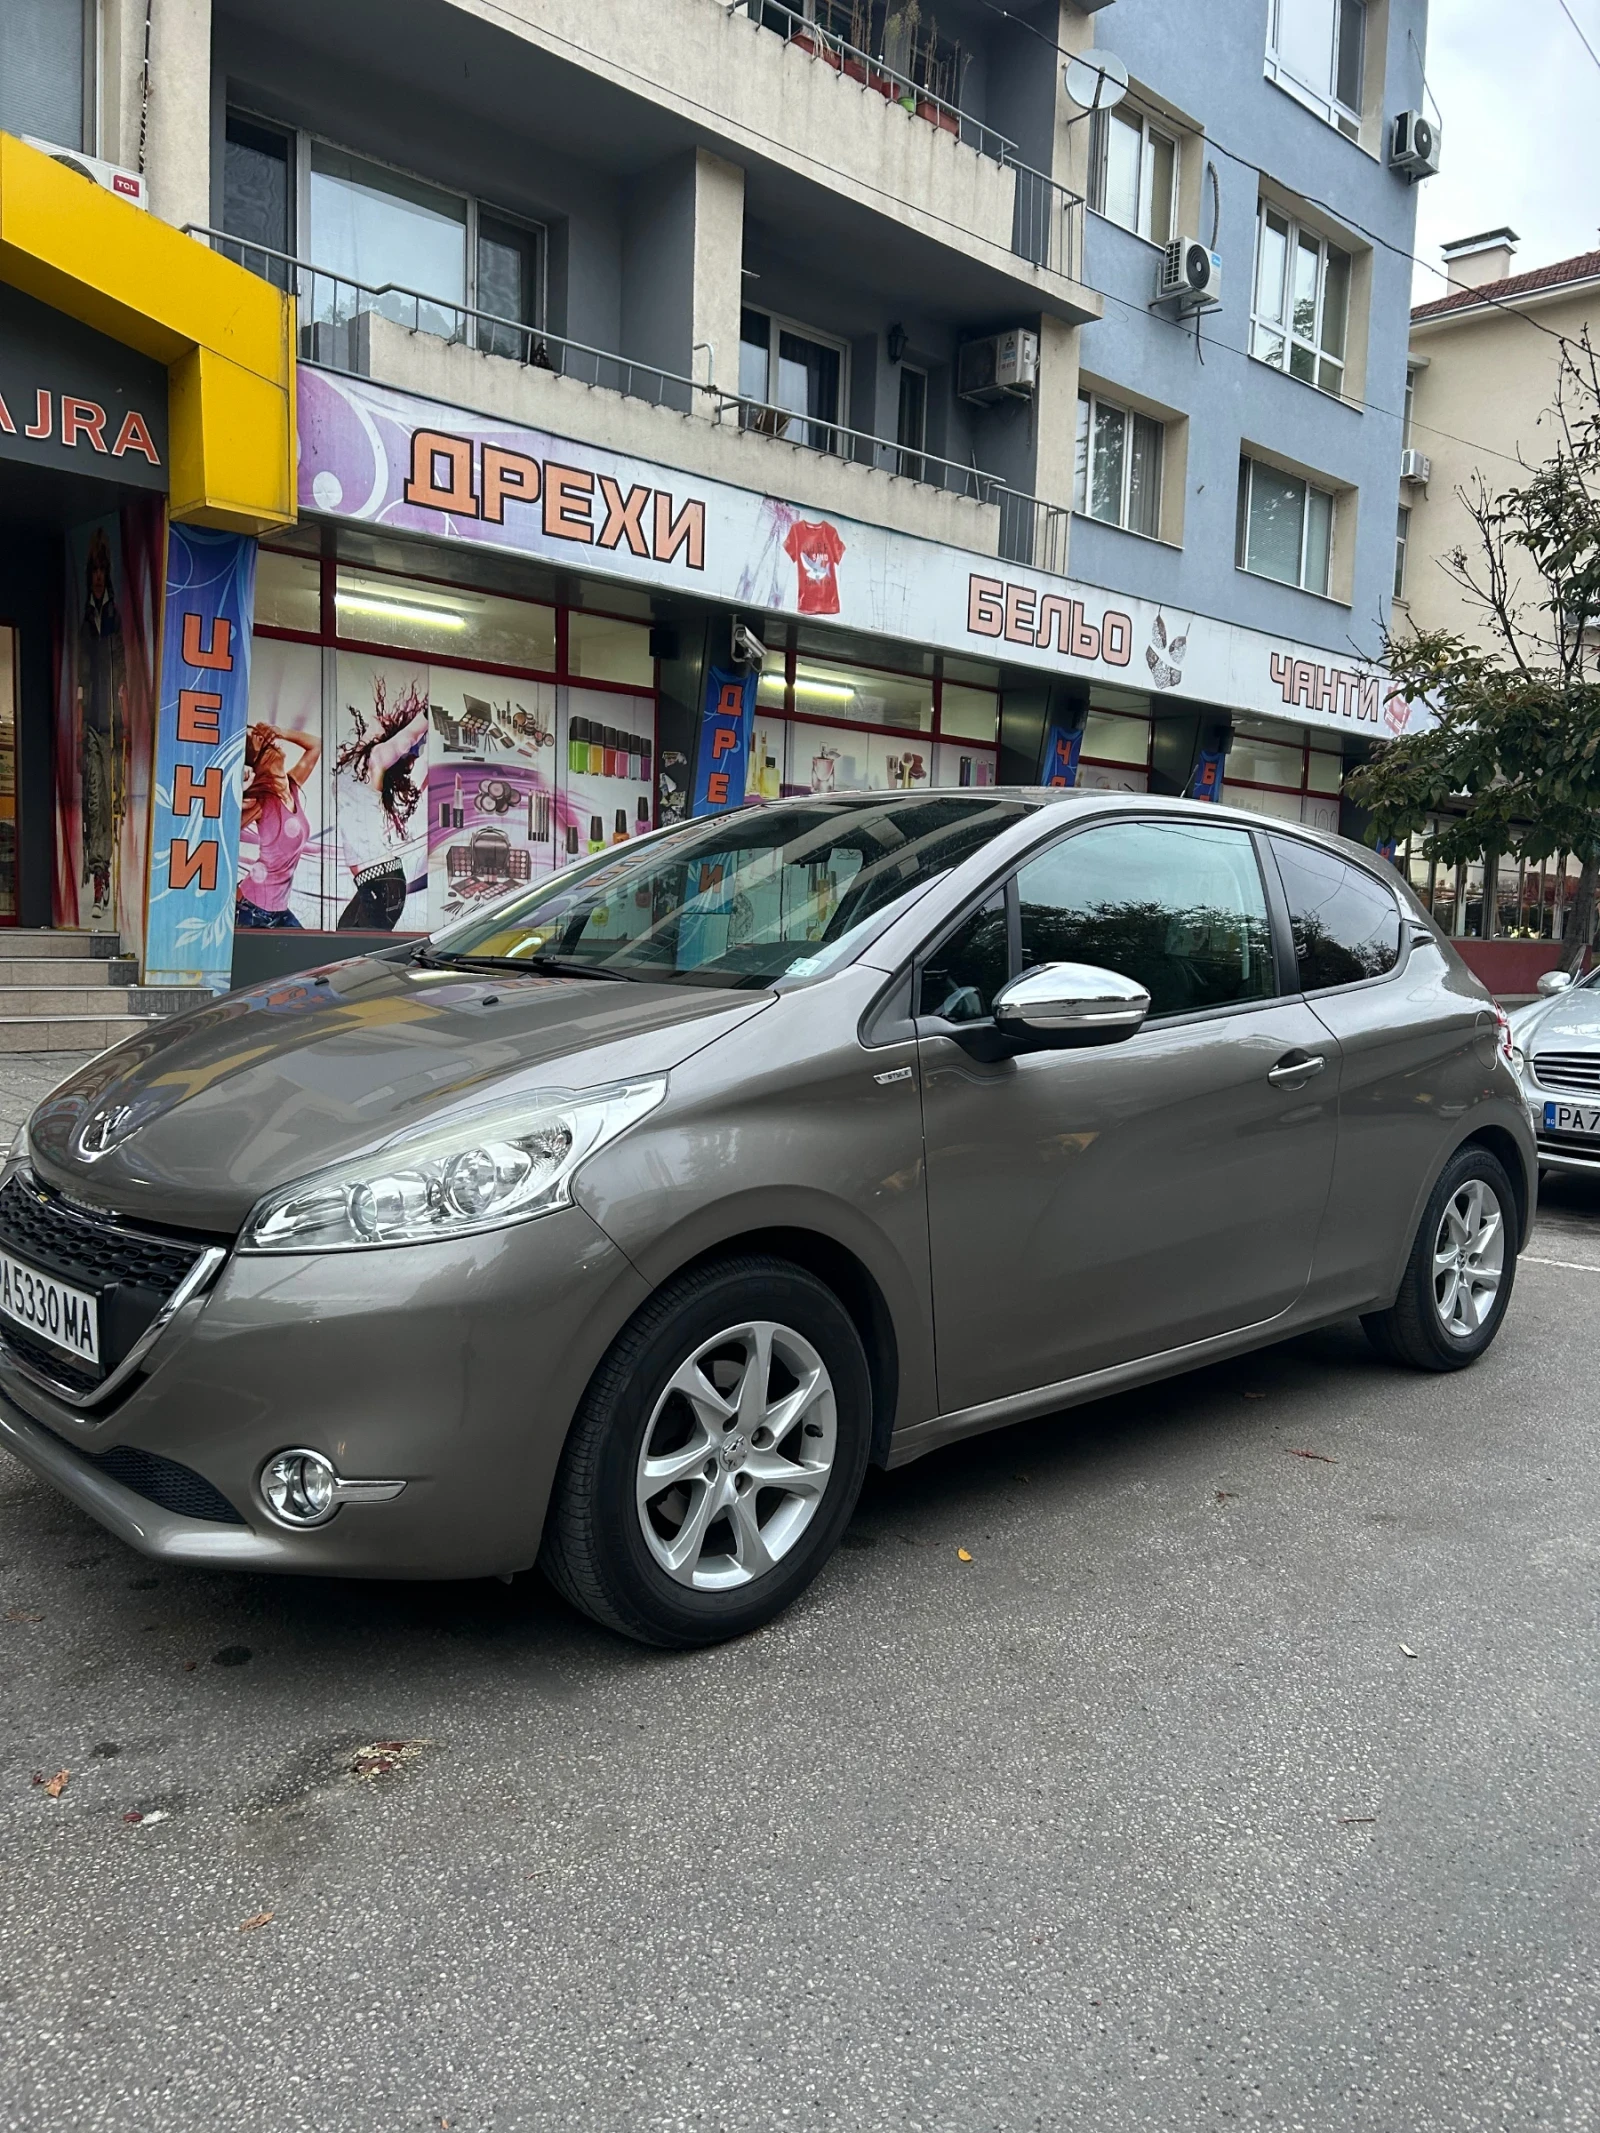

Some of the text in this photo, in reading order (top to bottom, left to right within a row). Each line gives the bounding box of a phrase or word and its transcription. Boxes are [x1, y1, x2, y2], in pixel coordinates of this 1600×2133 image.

[117, 180, 136, 192] TCL
[403, 427, 706, 571] ДРЕХИ
[967, 572, 1132, 666] БЕЛЬО
[1269, 652, 1380, 723] ЧАНТИ
[168, 612, 234, 891] ЦЕНИ
[0, 1257, 94, 1354] A5330MA
